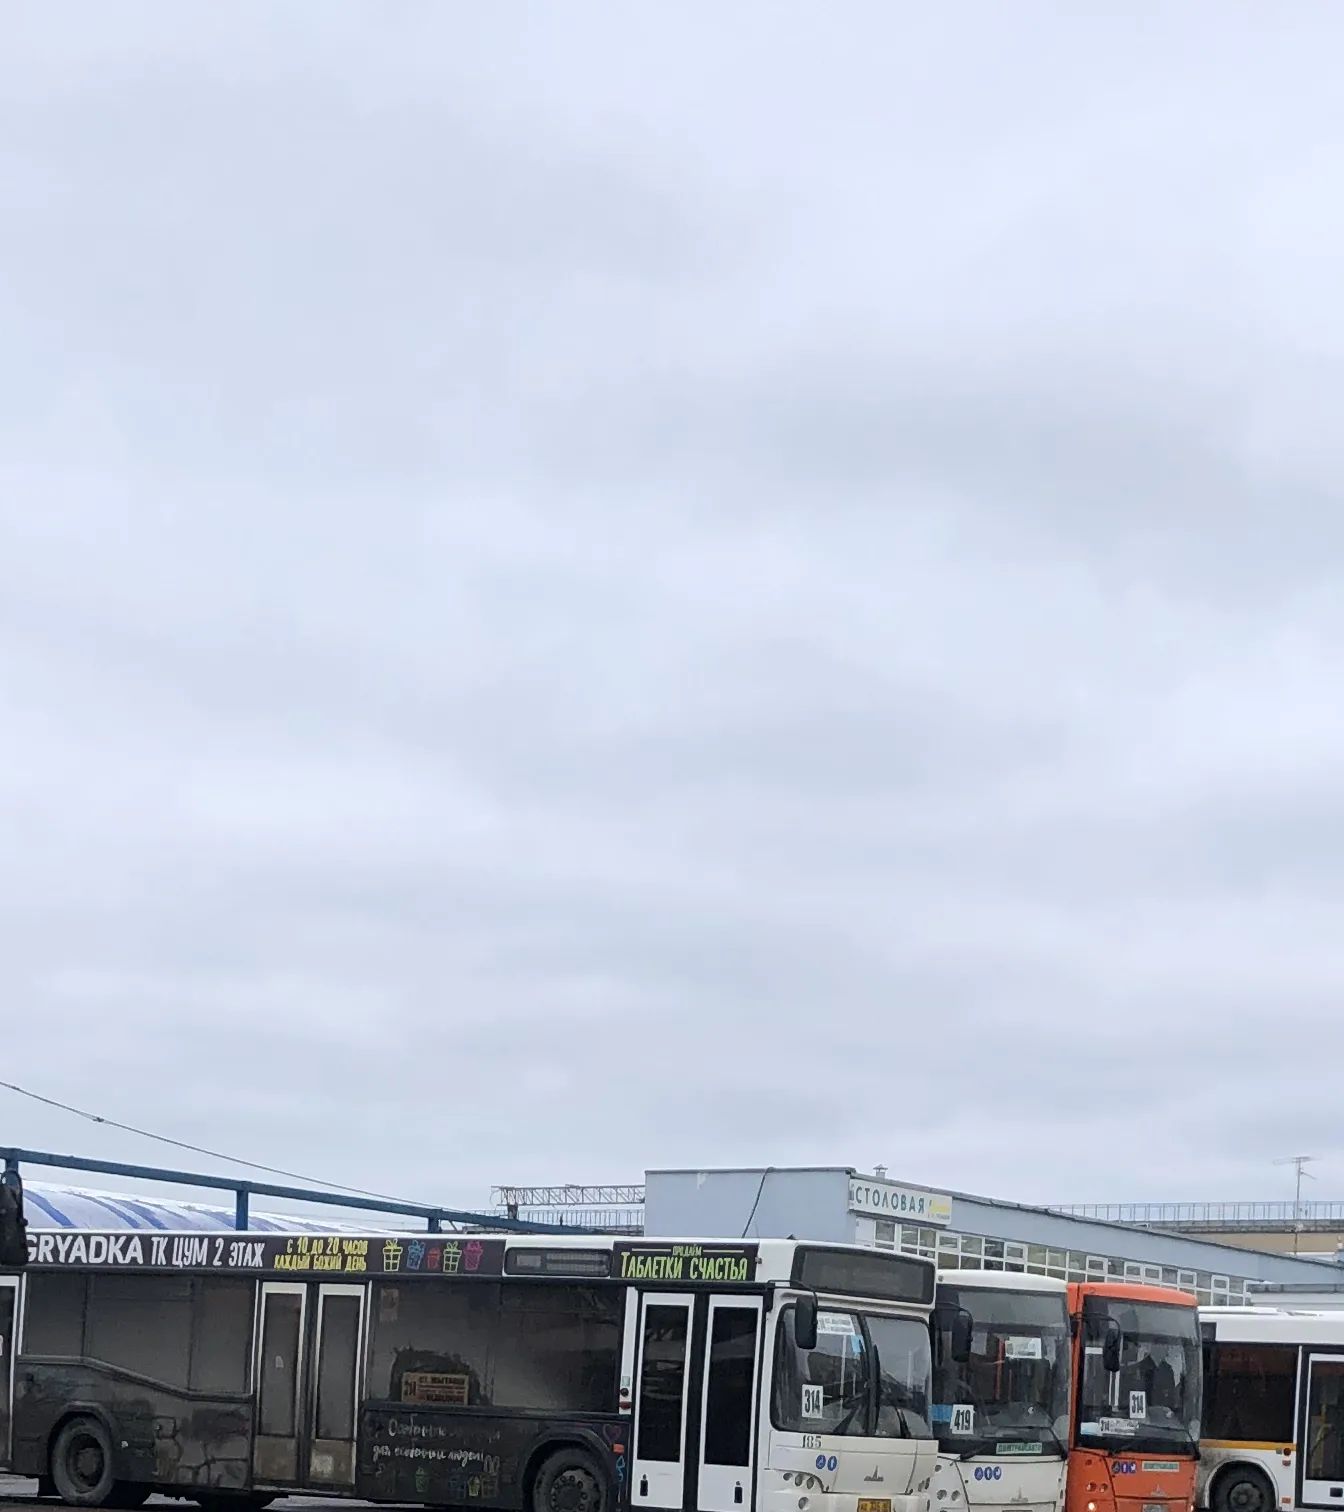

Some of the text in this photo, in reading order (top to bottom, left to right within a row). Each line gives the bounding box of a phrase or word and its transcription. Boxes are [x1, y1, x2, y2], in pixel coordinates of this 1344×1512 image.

[855, 1186, 925, 1215] СТОЛОВАЯ
[151, 1236, 167, 1266] ТК
[172, 1237, 208, 1269] ЦУМ
[212, 1238, 223, 1267] 2
[229, 1241, 265, 1268] ЭТАЖ
[297, 1236, 309, 1254] 10
[326, 1237, 340, 1254] 20
[342, 1239, 369, 1255] ЧАСОВ
[274, 1252, 367, 1271] КАЖДЫЙ БОЖИЙ ДЕНЬ
[689, 1256, 748, 1280] СЧАСТЬЯ
[804, 1389, 821, 1414] 314
[1131, 1394, 1144, 1414] 314
[954, 1409, 971, 1431] 419
[801, 1435, 822, 1449] 185
